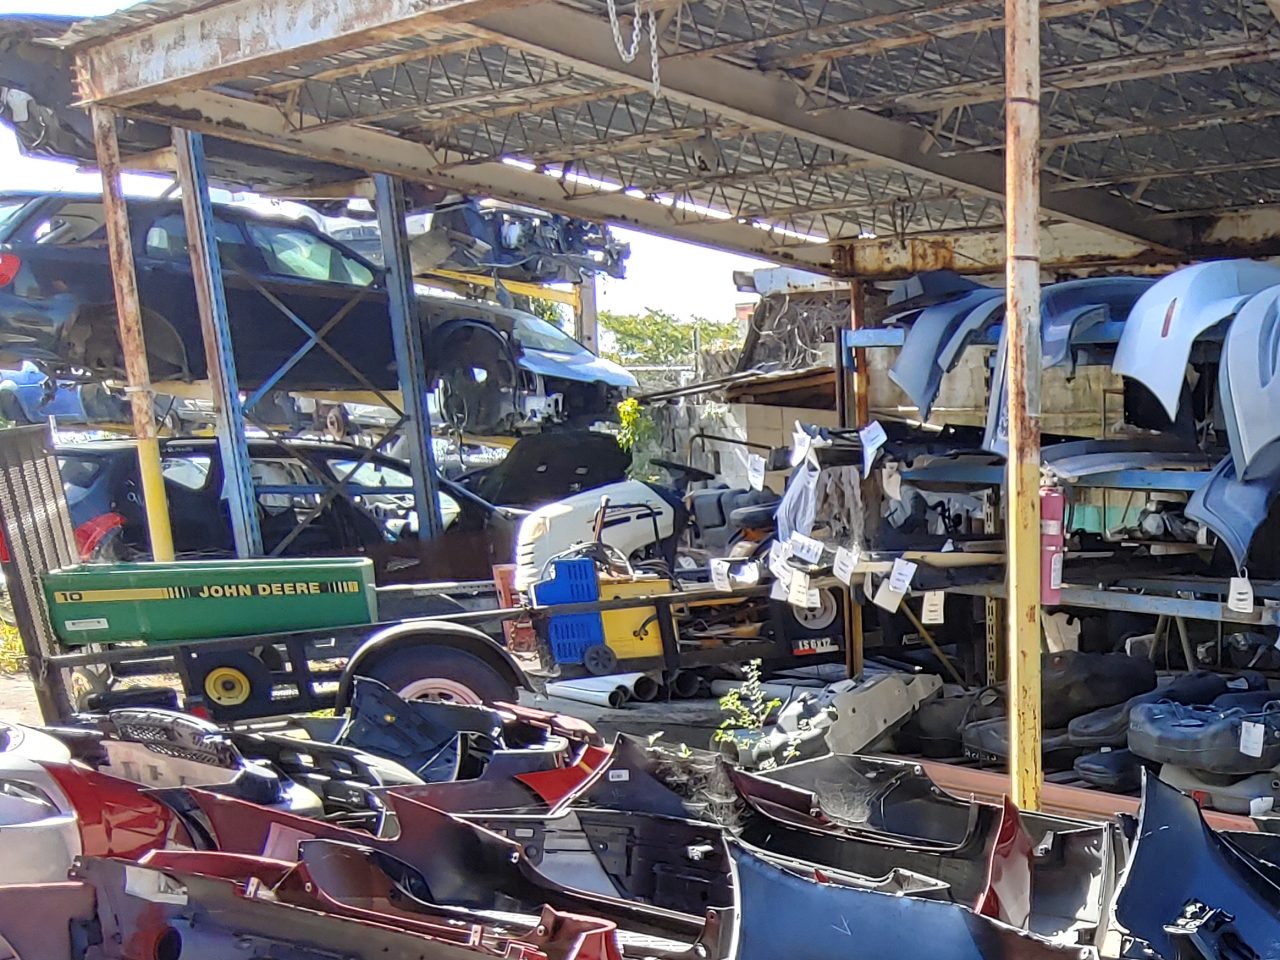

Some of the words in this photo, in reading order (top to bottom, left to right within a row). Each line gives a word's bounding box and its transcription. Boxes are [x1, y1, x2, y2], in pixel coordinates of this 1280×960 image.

[60, 591, 84, 603] 10
[199, 583, 252, 599] JOHN
[258, 581, 321, 596] DEERE
